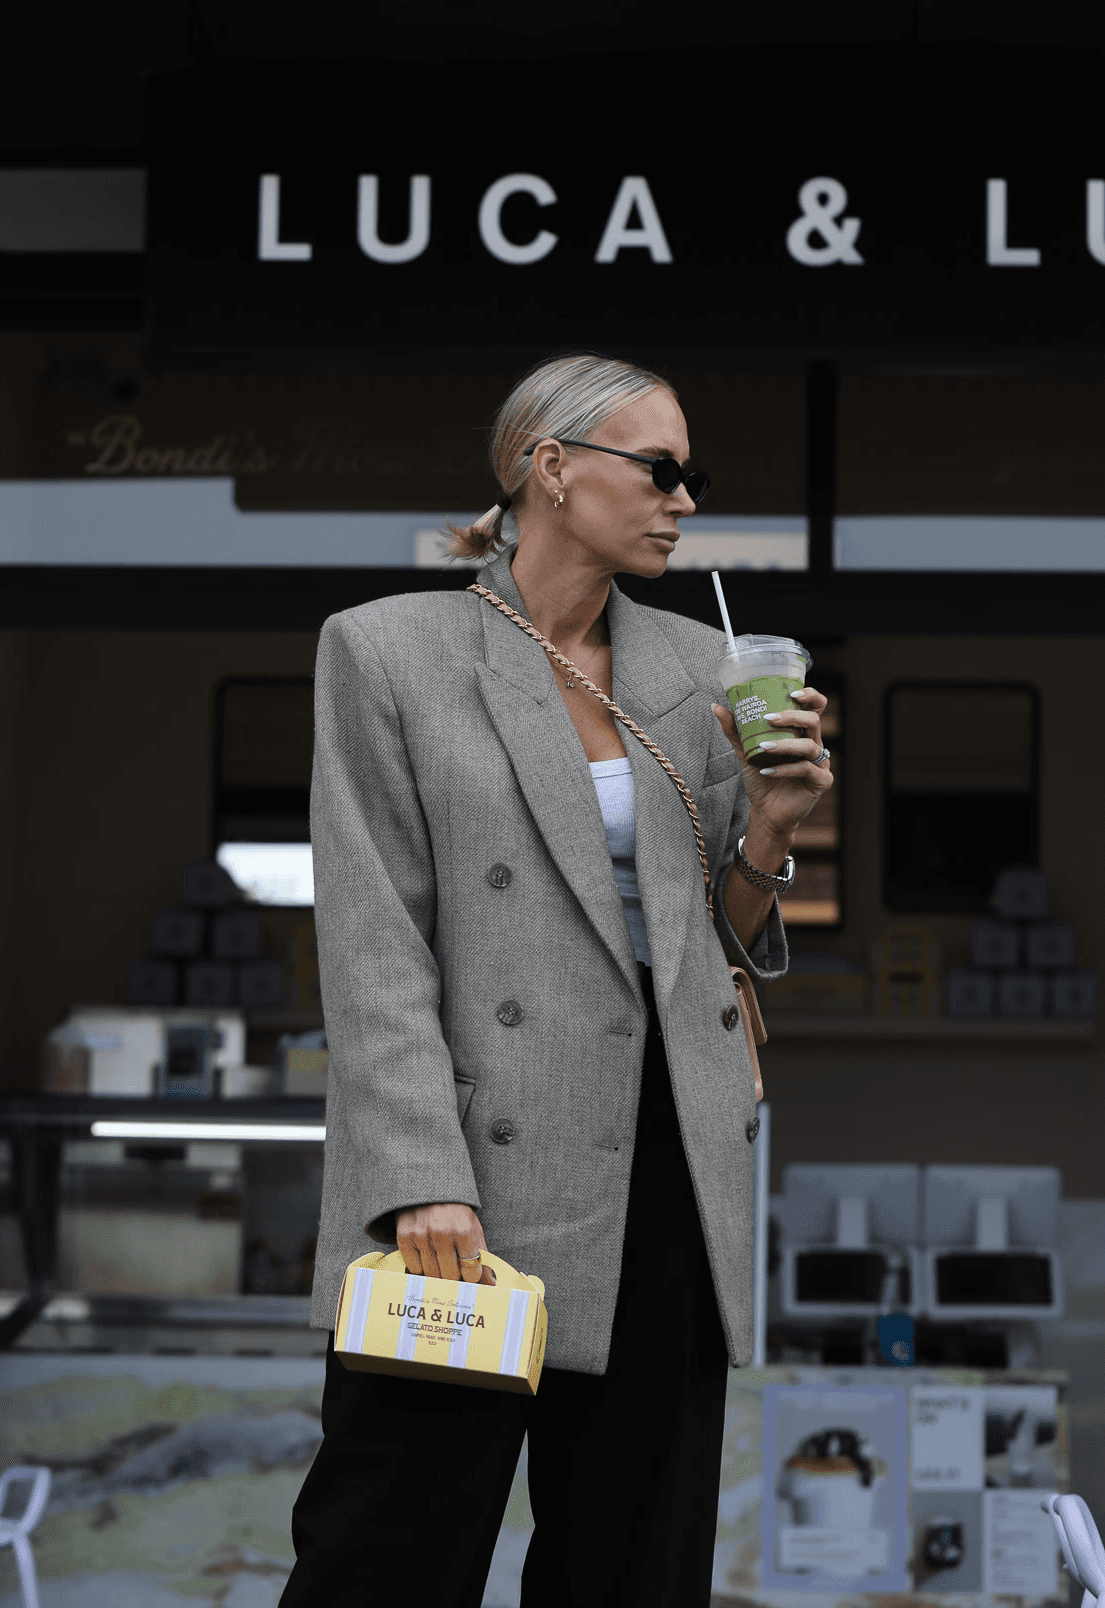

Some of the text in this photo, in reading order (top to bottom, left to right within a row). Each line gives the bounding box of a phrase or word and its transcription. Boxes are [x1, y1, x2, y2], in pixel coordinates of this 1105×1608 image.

[259, 174, 671, 263] LUCA
[787, 178, 862, 265] &
[387, 1302, 485, 1328] LUCA & LUCA
[407, 1322, 434, 1332] GELATO
[434, 1325, 463, 1336] SHOPPE
